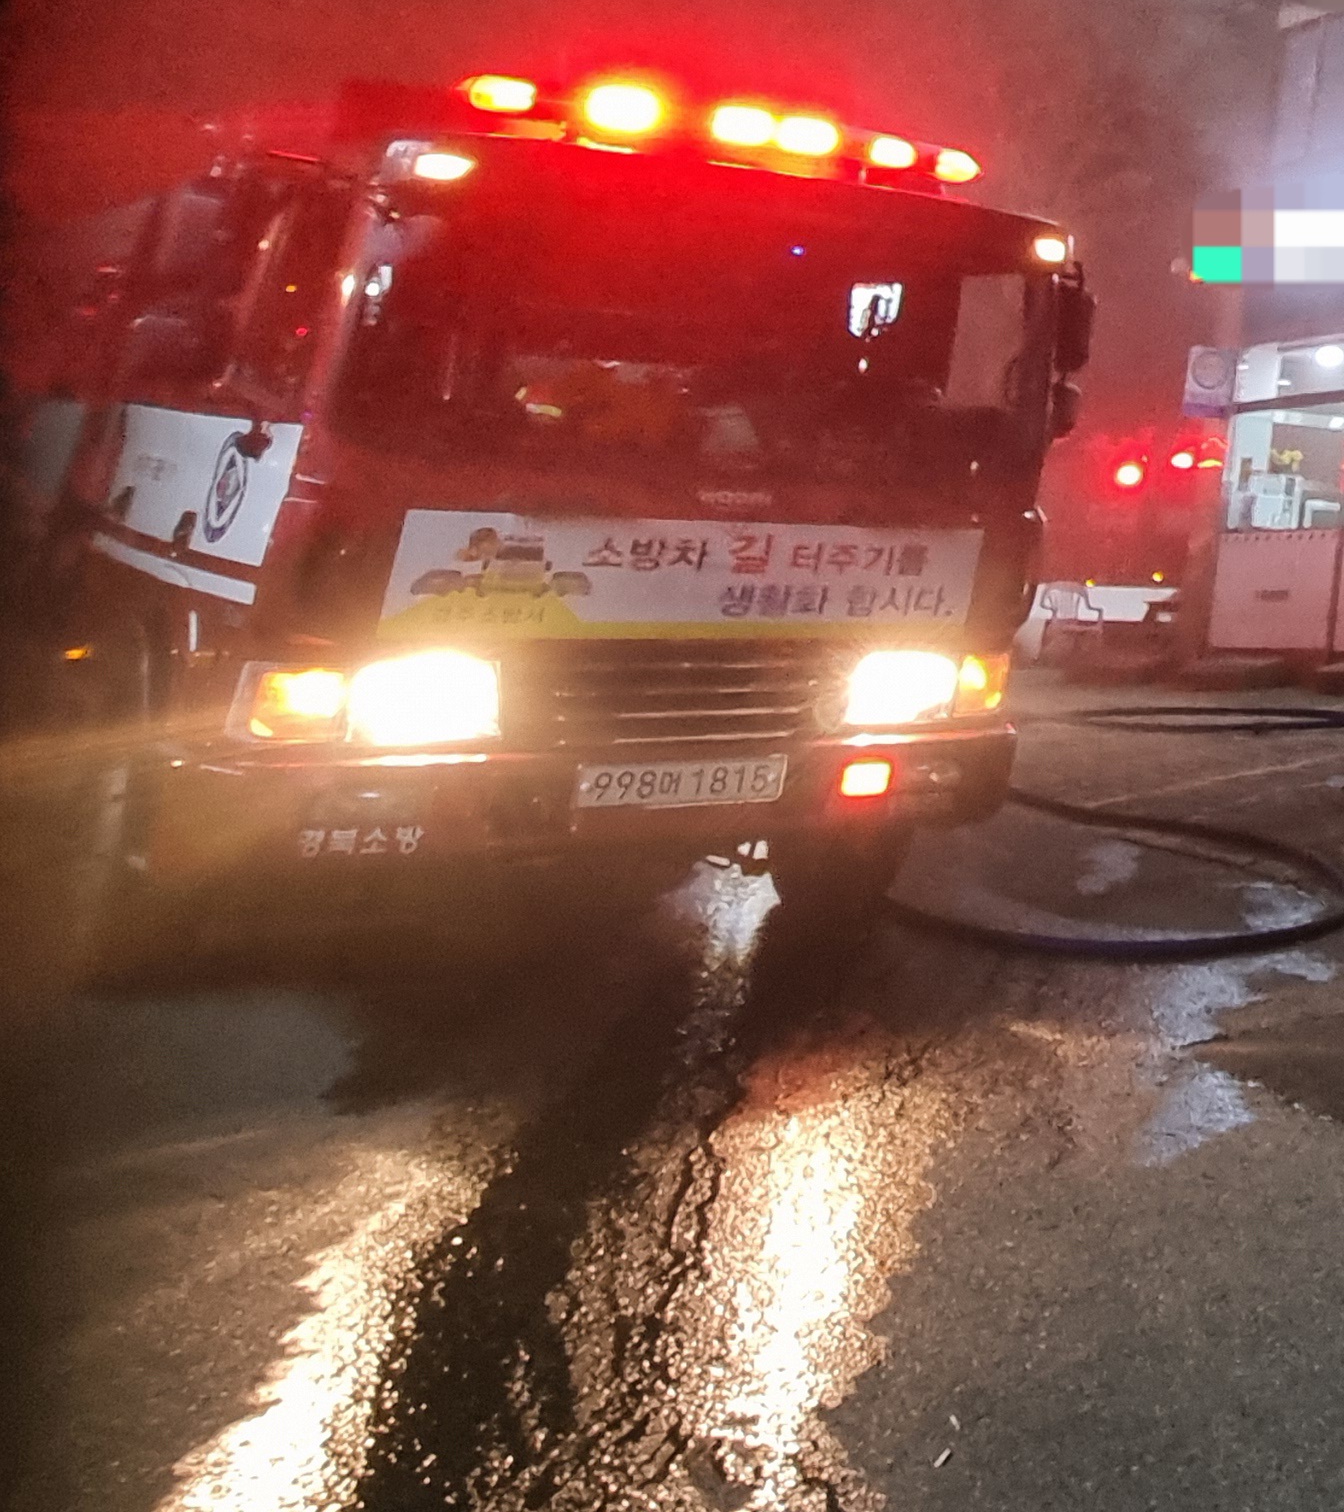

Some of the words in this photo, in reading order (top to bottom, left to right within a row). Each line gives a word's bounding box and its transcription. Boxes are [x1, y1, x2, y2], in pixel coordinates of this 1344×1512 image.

[581, 536, 709, 572] 소방차
[727, 533, 775, 575] 길
[298, 824, 425, 858] 경북소방
